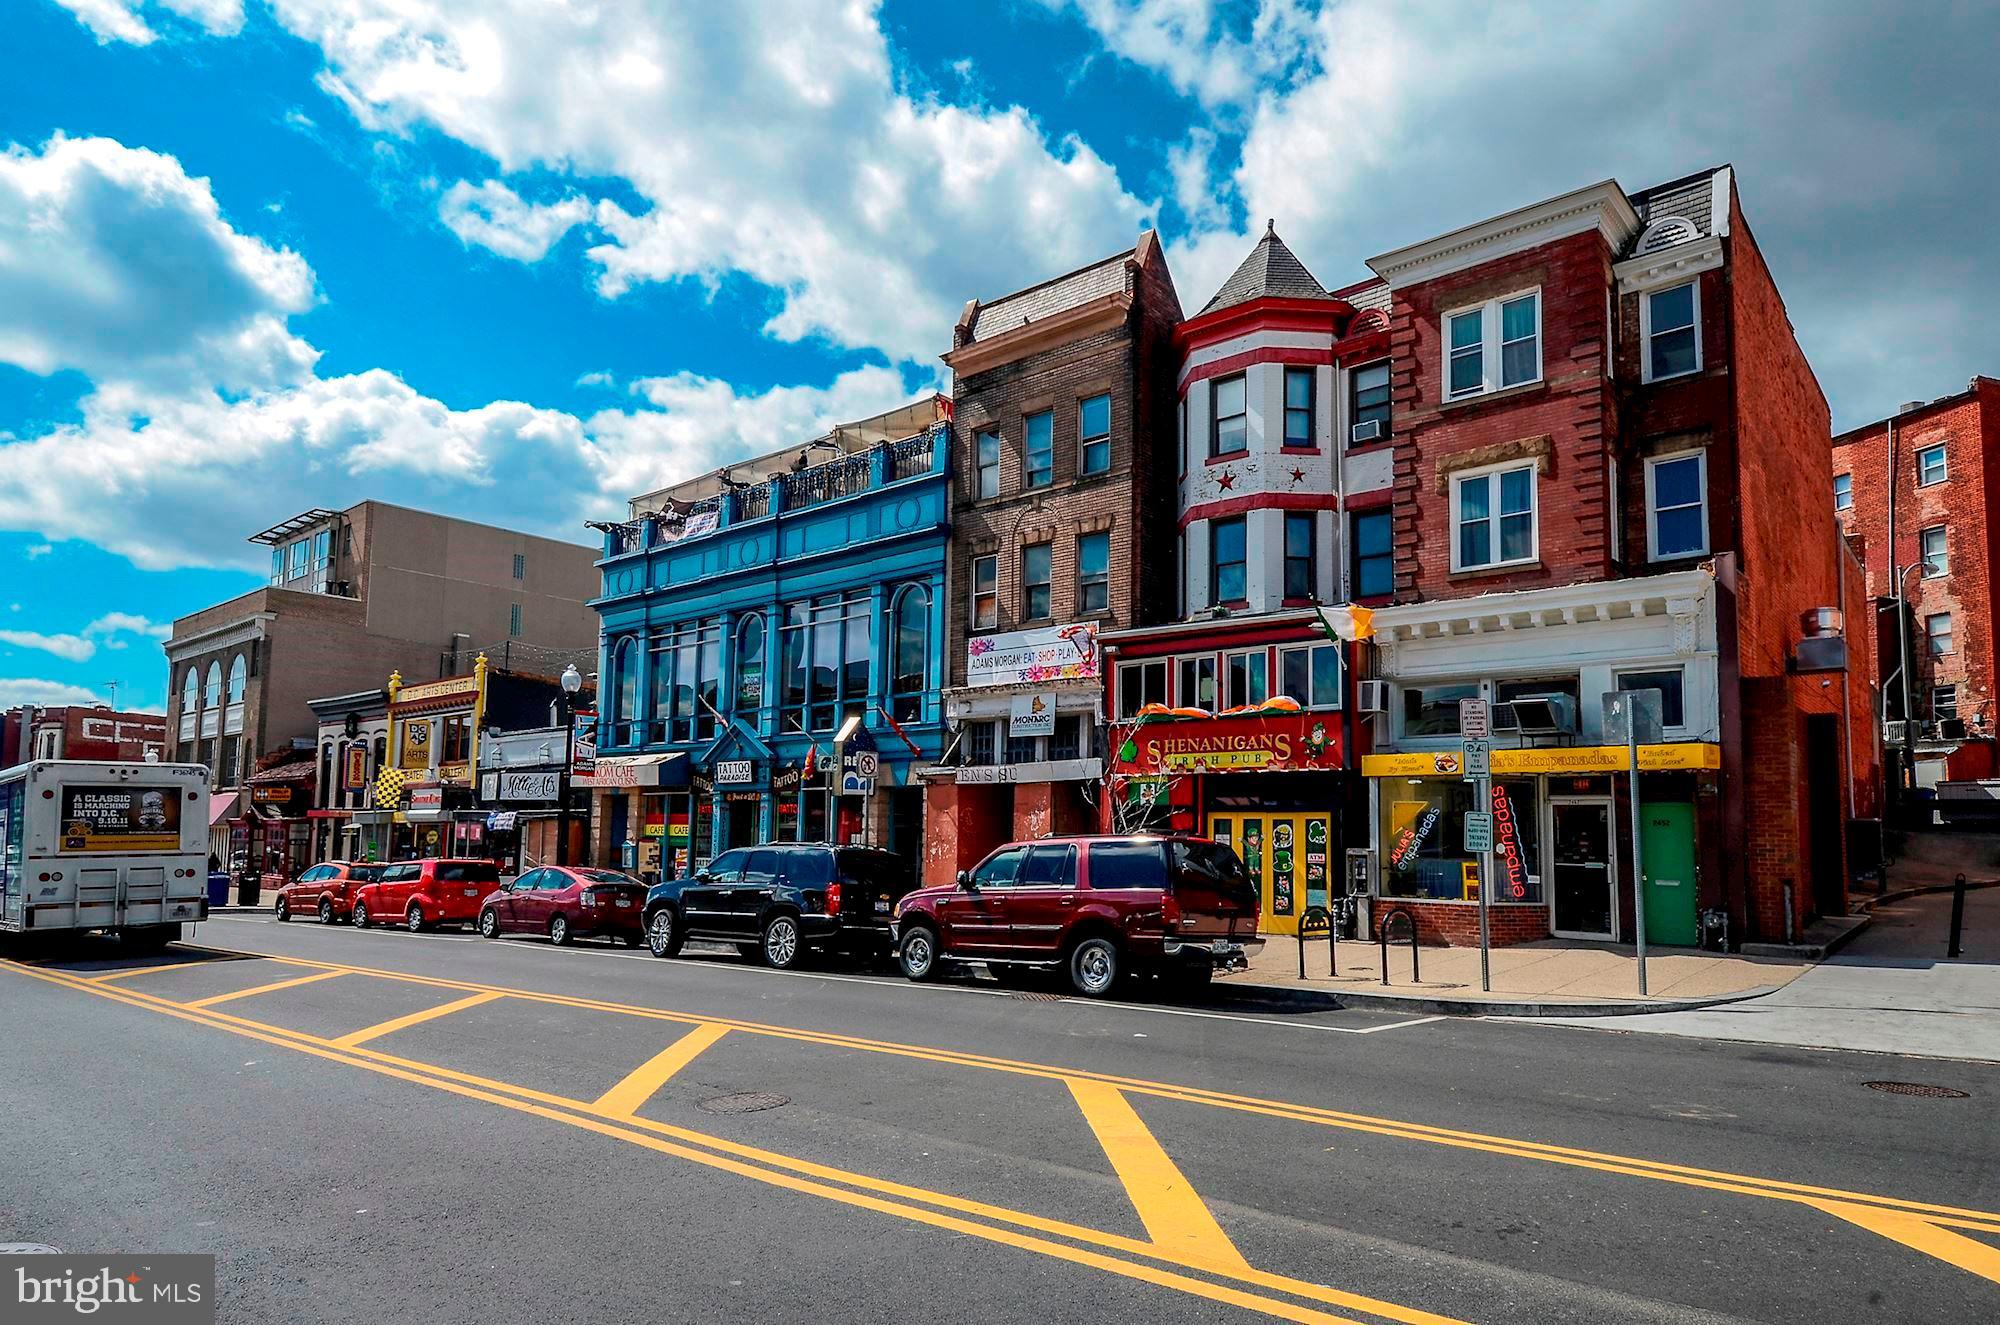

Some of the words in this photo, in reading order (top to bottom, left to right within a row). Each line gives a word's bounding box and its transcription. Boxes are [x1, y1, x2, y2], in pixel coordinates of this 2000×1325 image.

[971, 656, 994, 670] ADAMS
[1023, 651, 1035, 664] EAT
[1038, 649, 1055, 663] SHOP
[1058, 648, 1075, 660] PLAY
[422, 686, 439, 696] ARTS
[440, 680, 468, 694] CENTER
[576, 716, 597, 761] EAT
[406, 750, 428, 759] ARTS
[1147, 733, 1292, 765] SHENANIGANS
[718, 763, 750, 774] TATTOO
[1174, 756, 1219, 766] IRISH
[1231, 754, 1262, 764] PUB
[1518, 750, 1618, 771] Empanadas
[440, 767, 467, 780] GALLERY
[616, 765, 635, 777] CAFE
[773, 769, 799, 788] TATTOO
[597, 777, 616, 785] AFRICAN
[618, 776, 638, 784] CUISINE
[650, 826, 665, 834] CAFE
[674, 826, 689, 834] CAFE
[1391, 830, 1415, 864] JULIA'S
[1398, 807, 1441, 871] empanadas
[1492, 785, 1525, 898] empanadas
